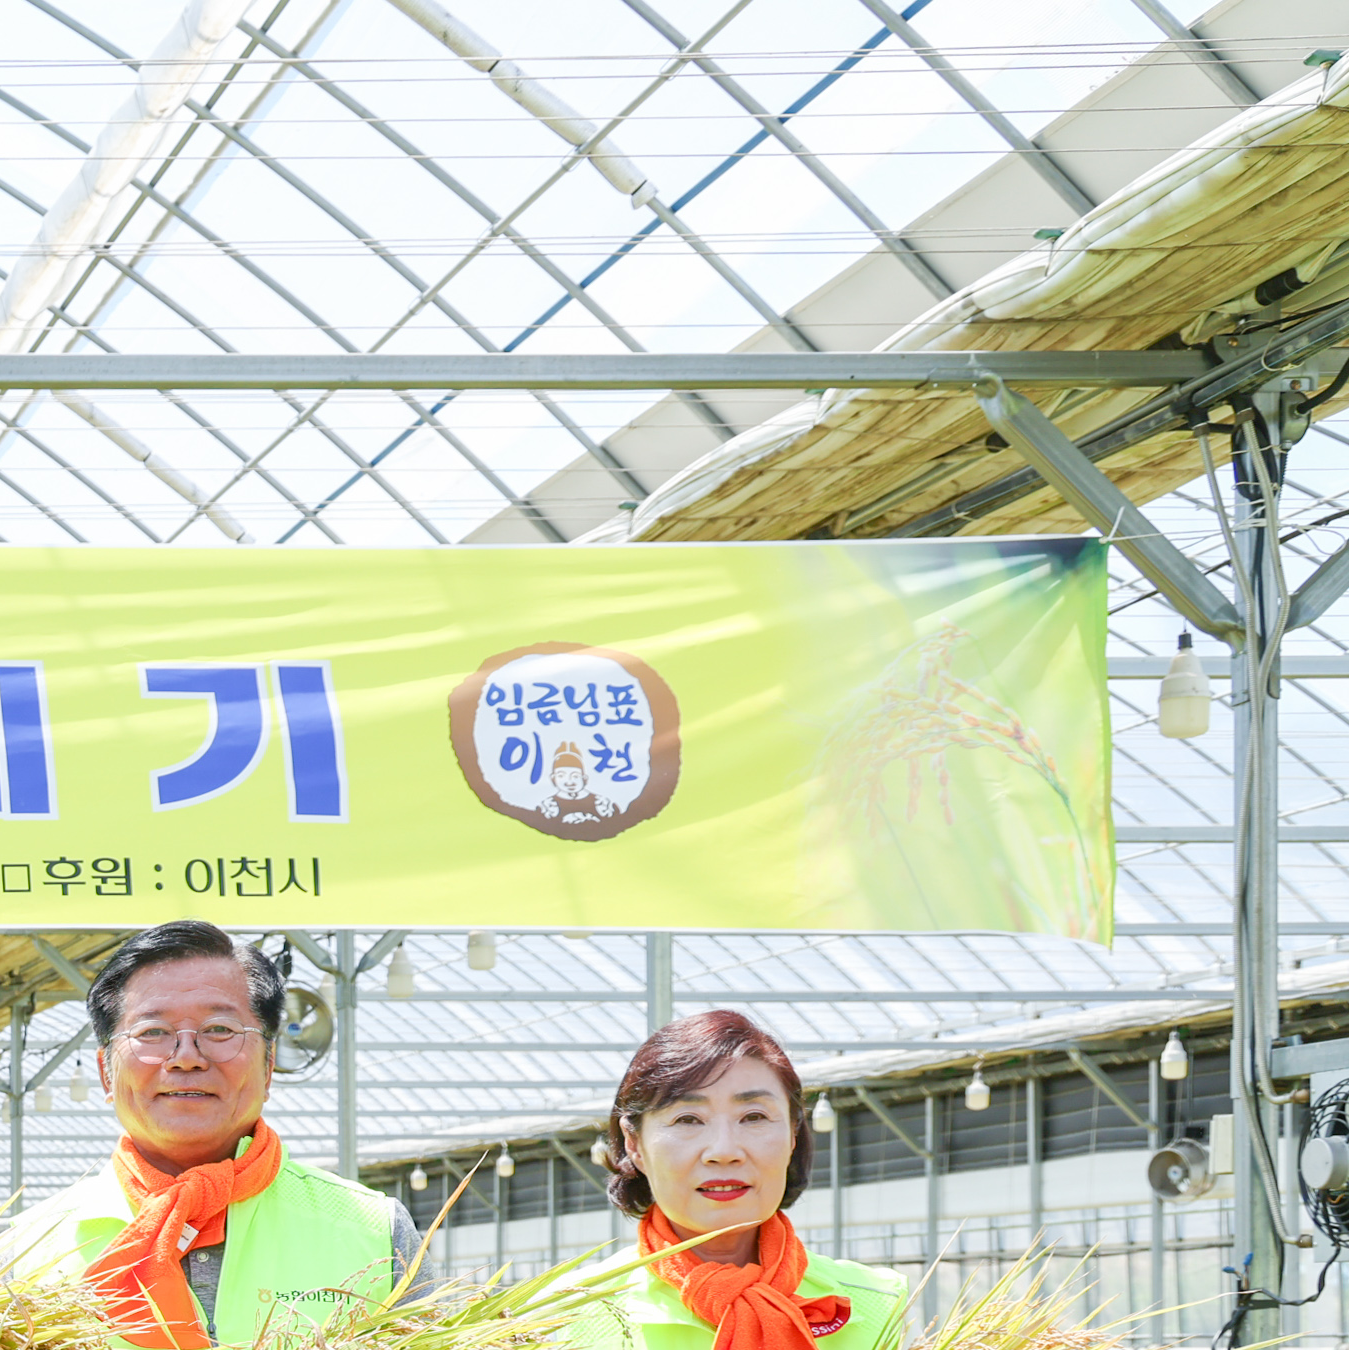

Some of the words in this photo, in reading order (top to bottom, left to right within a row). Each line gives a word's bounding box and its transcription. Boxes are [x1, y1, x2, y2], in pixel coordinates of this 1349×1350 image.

[485, 682, 644, 727] 임금님표
[42, 856, 133, 897] 후원
[184, 856, 321, 898] 이천시
